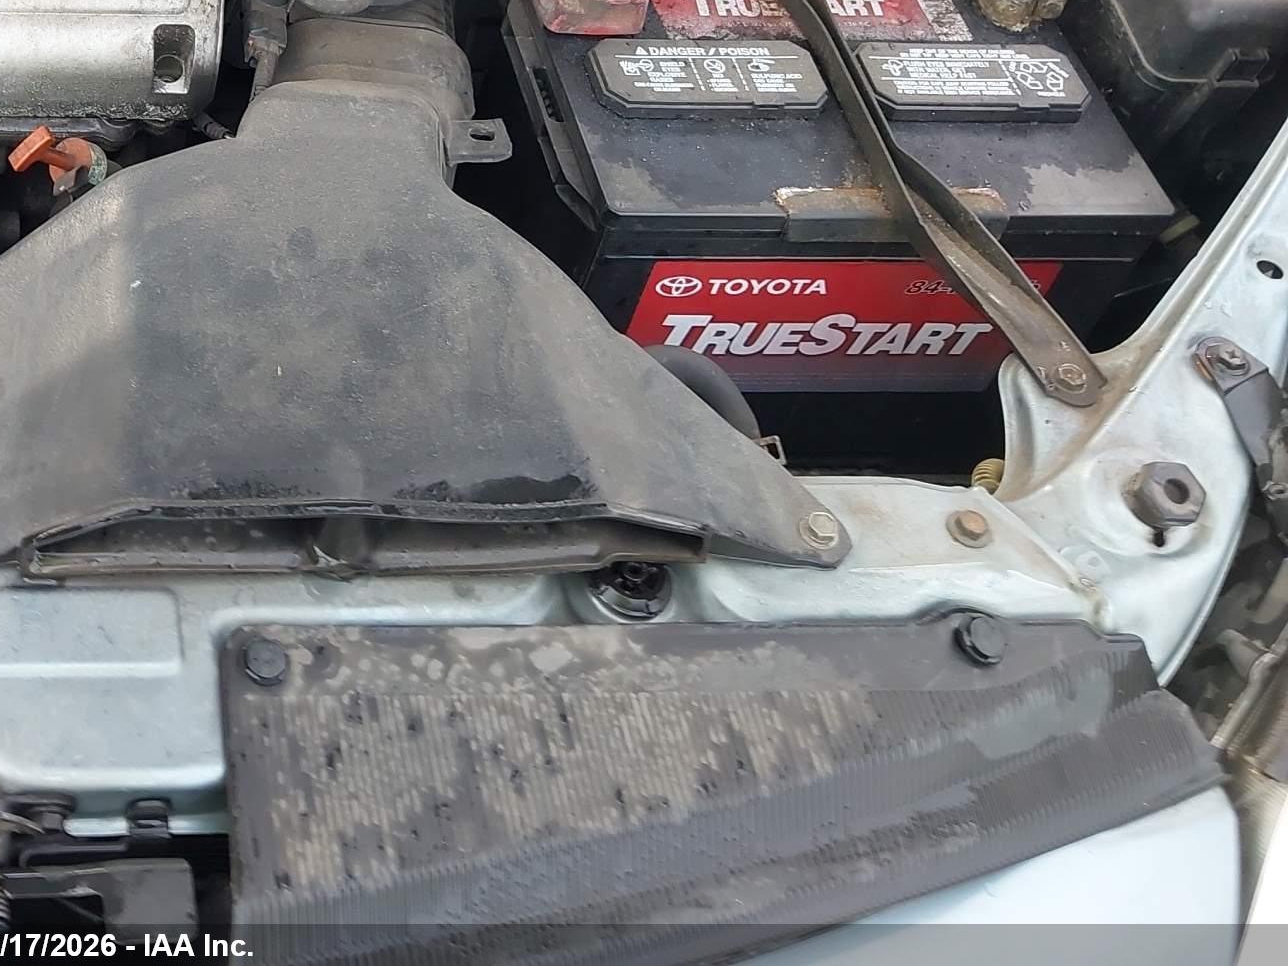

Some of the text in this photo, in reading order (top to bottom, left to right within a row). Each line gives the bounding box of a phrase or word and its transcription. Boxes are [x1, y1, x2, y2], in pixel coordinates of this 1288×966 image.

[648, 47, 707, 56] DANGER
[719, 47, 770, 56] POISON
[707, 278, 828, 295] TOYOTA
